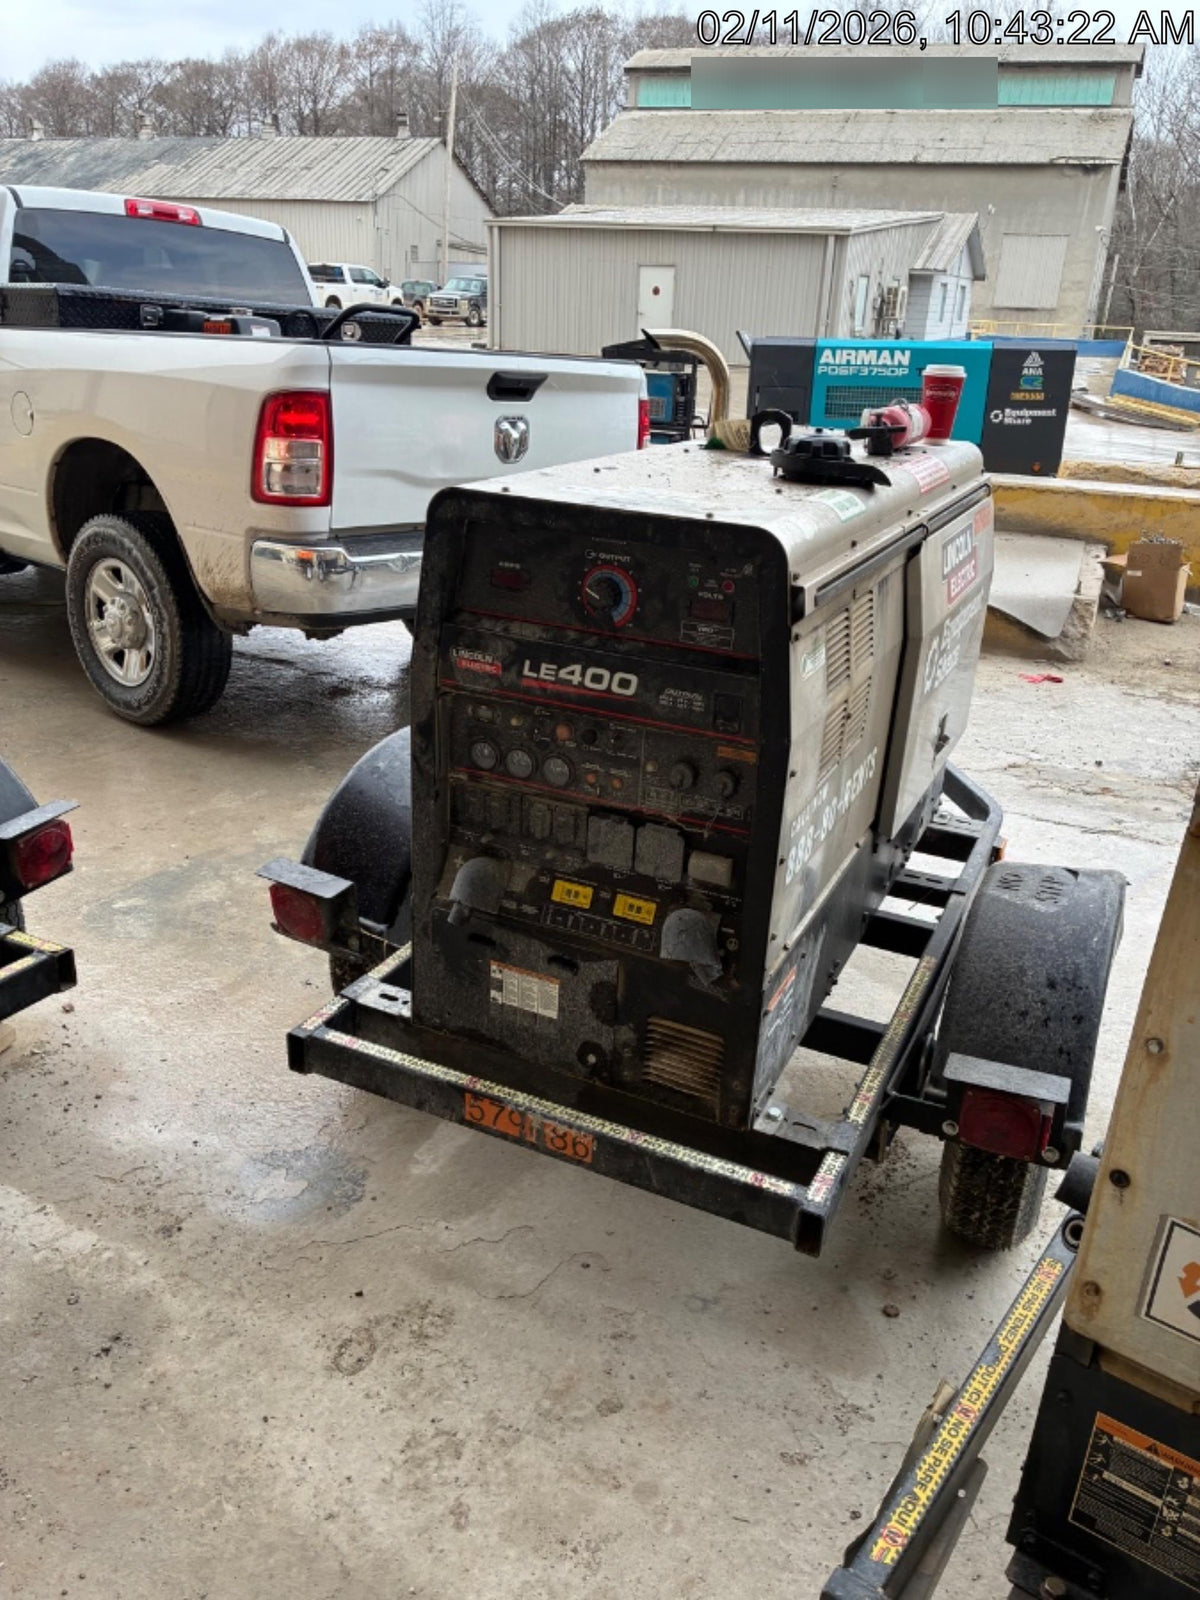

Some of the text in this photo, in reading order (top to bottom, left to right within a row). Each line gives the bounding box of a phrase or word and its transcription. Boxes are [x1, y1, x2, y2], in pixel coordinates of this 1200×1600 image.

[820, 348, 911, 366] AIRMAN
[452, 649, 493, 663] LINCOLN
[522, 659, 638, 696] LE400
[1021, 1291, 1040, 1313] PAS
[1003, 1311, 1028, 1344] TENEZ
[966, 1386, 984, 1406] ICI
[946, 1417, 965, 1439] NO
[934, 1436, 953, 1457] SE
[914, 1455, 943, 1493] PARE
